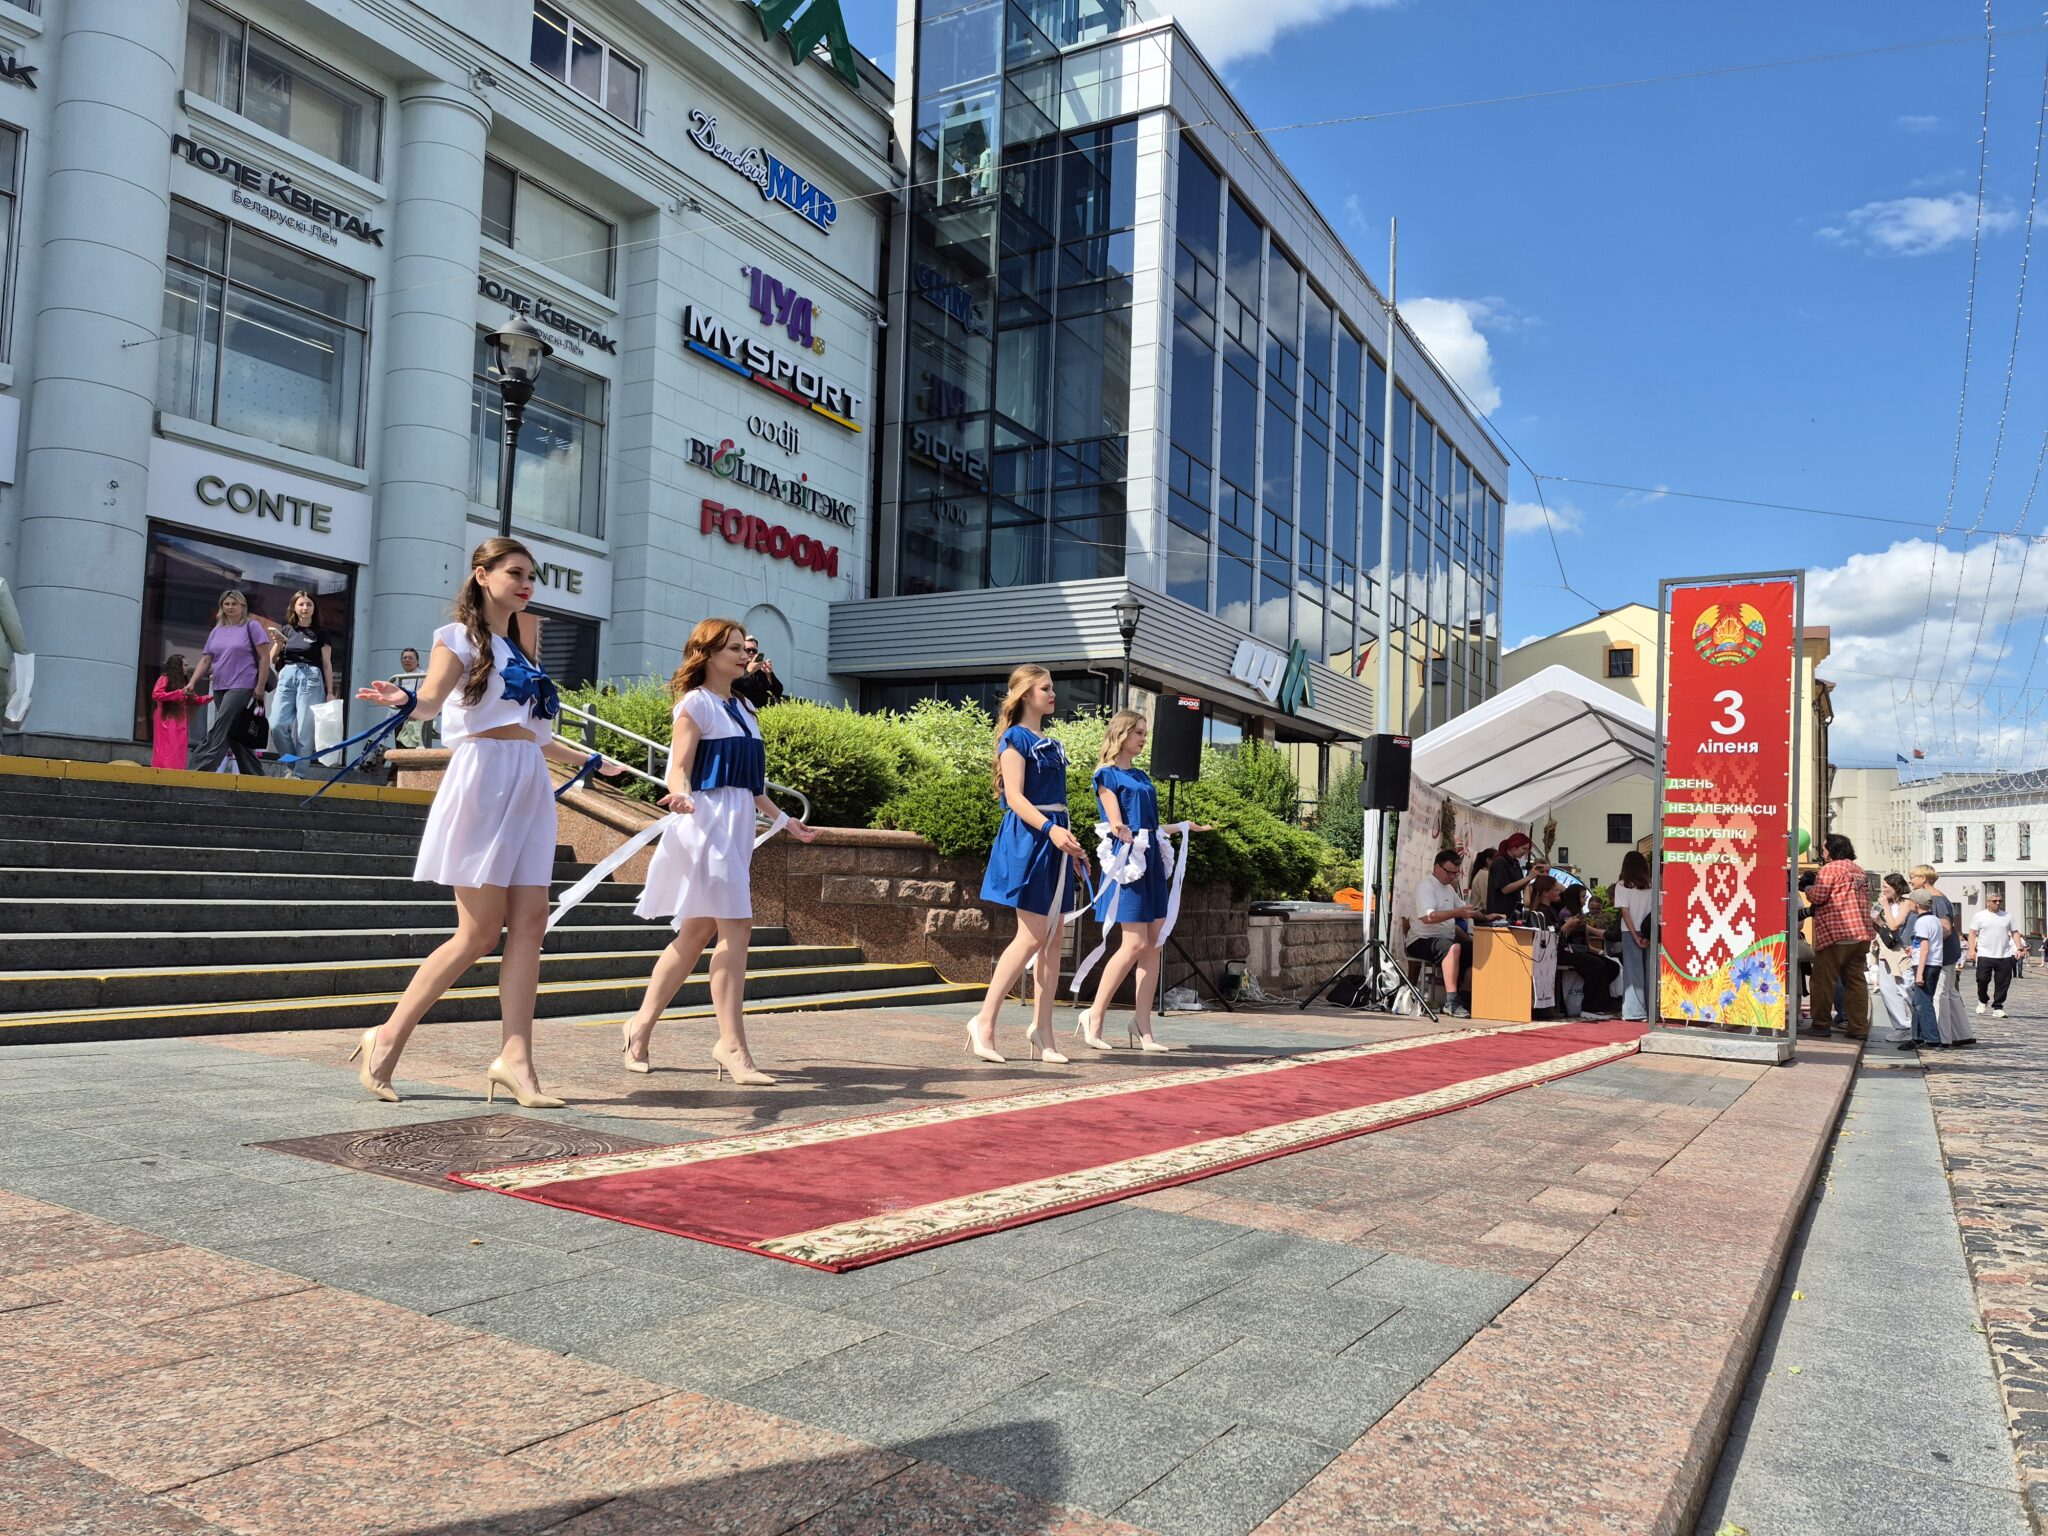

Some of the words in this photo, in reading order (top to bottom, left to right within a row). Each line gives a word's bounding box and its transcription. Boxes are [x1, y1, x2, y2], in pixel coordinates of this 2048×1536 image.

[172, 133, 262, 191] ПОЛЕ
[268, 171, 384, 247] КВЕТАК
[763, 149, 838, 235] МИР
[308, 223, 338, 246] Лен
[535, 298, 617, 355] КВЕТАК
[685, 304, 863, 420] MYSPORT
[748, 415, 800, 456] oodji
[196, 475, 333, 533] CONTE
[701, 499, 839, 577] FOROOM
[533, 560, 583, 594] NTE
[1710, 689, 1746, 735] 3
[1697, 738, 1759, 754] ліпеня
[1669, 778, 1715, 790] ДЗЕНЬ
[1668, 802, 1777, 816] НЕЗАЛЕЖНАСЦІ
[1668, 827, 1747, 839] РЭСПУБЛІКІ
[1667, 852, 1740, 864] БЕЛАРУСЬ
